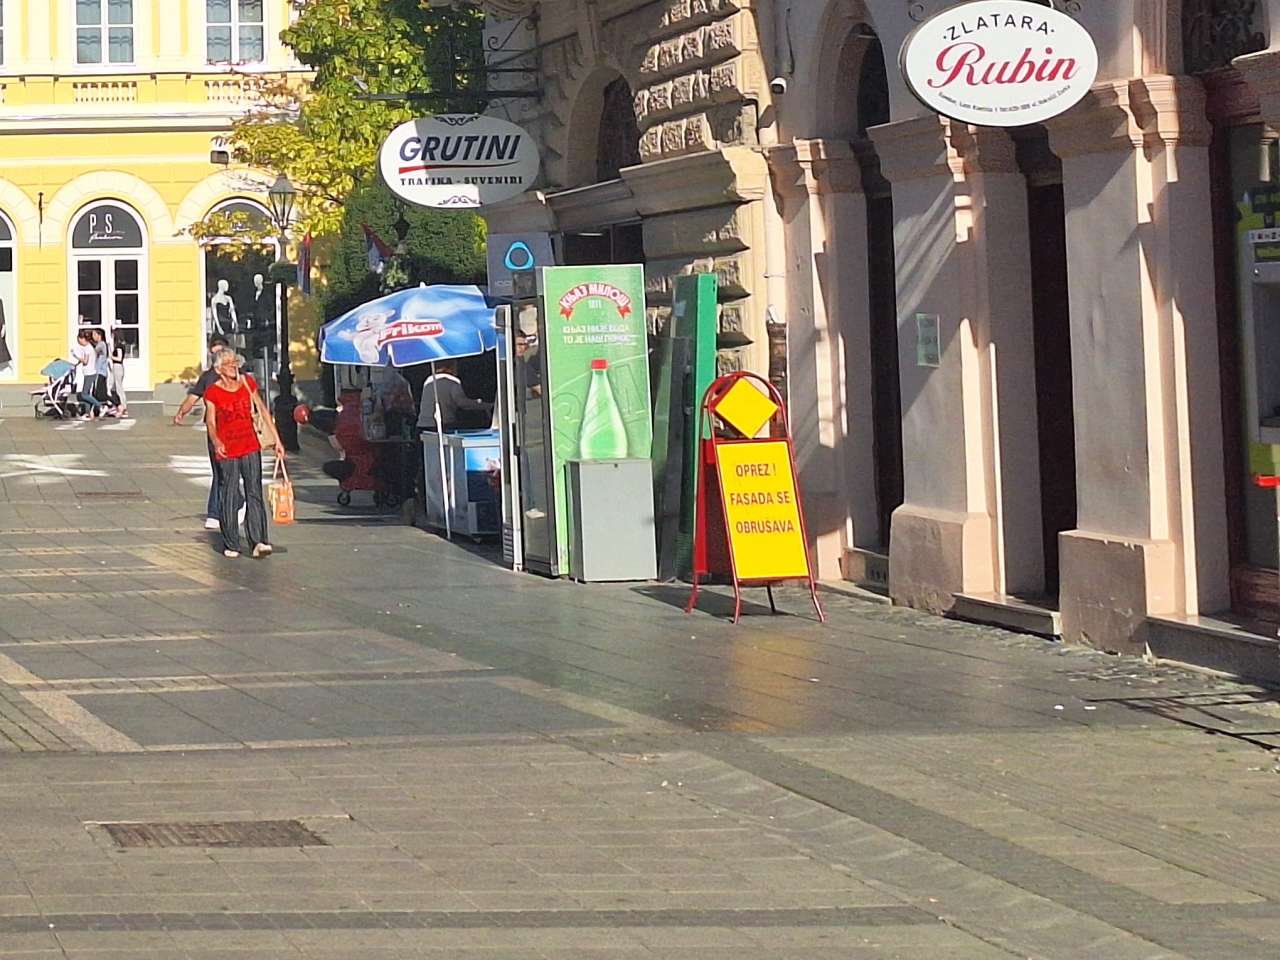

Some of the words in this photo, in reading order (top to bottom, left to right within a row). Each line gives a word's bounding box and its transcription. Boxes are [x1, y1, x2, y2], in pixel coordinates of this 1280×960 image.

[946, 14, 1051, 40] ZLATARA
[927, 41, 1080, 89] Rubin
[399, 135, 521, 161] GRUTINI
[400, 176, 453, 186] TRAFIKA
[463, 176, 523, 185] SUVENIRI
[559, 285, 588, 308] КЊАЗ
[588, 284, 630, 307] МИЛОШ
[735, 464, 770, 477] OPREZ
[730, 492, 774, 506] FASADA
[777, 491, 791, 504] SE
